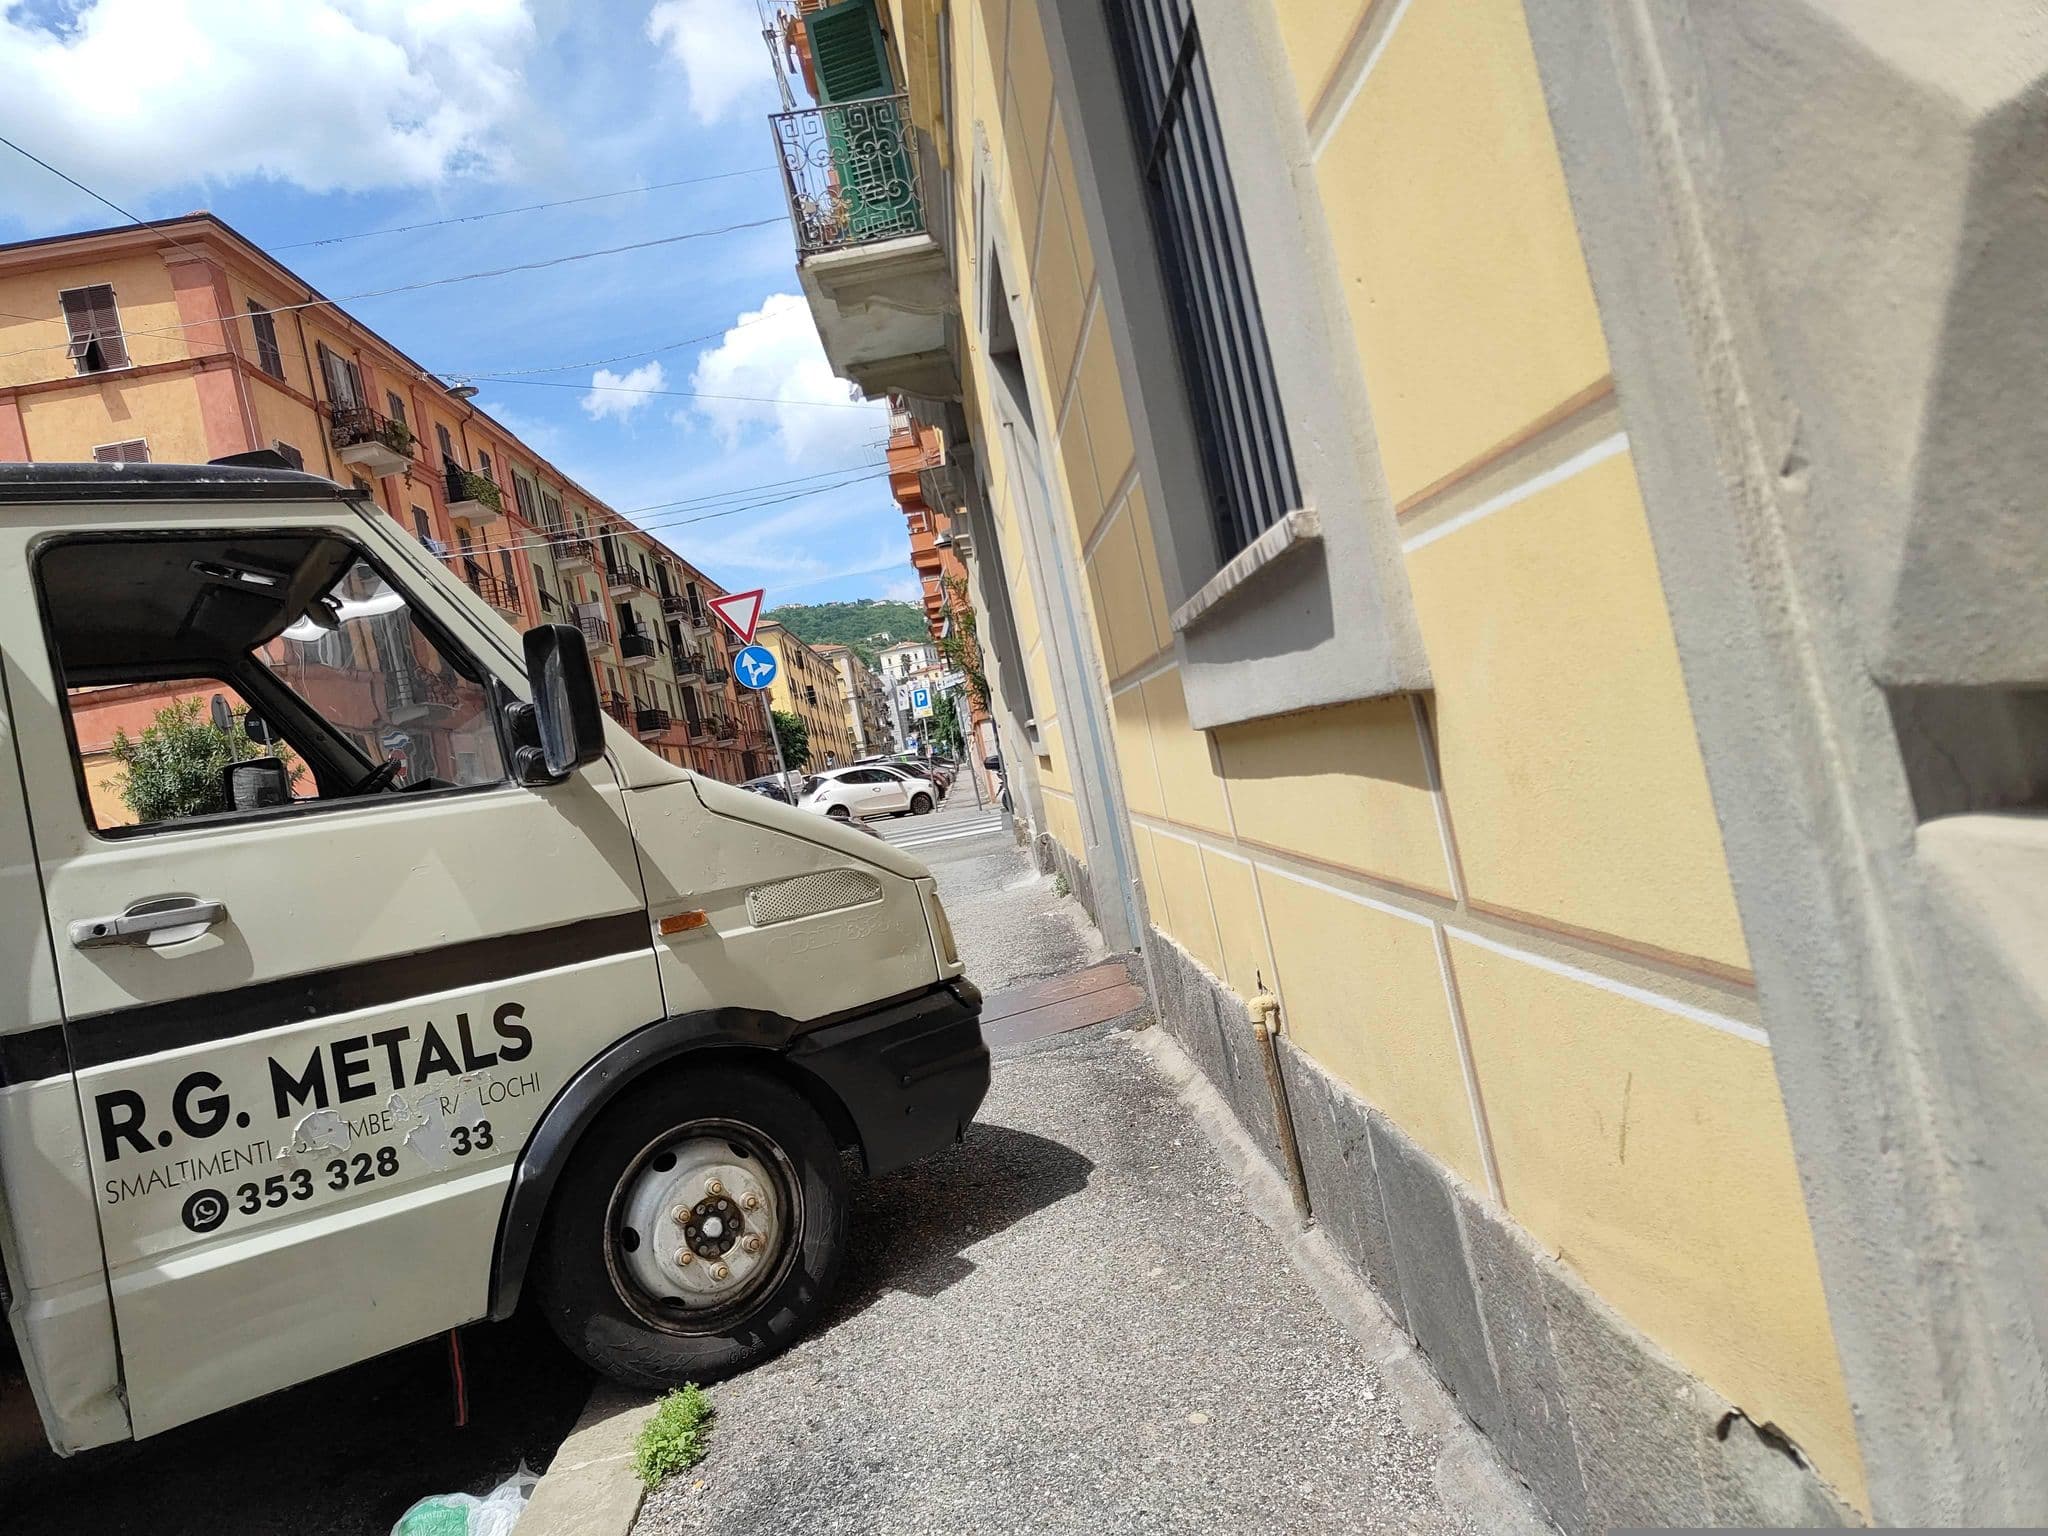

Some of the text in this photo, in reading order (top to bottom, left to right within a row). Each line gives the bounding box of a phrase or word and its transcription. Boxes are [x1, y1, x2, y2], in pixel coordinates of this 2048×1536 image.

[94, 1071, 251, 1163] R.G.
[267, 1001, 534, 1120] METALS
[105, 1139, 273, 1205] SMALTIMENTI
[236, 1168, 314, 1216] 353
[325, 1146, 400, 1192] 328
